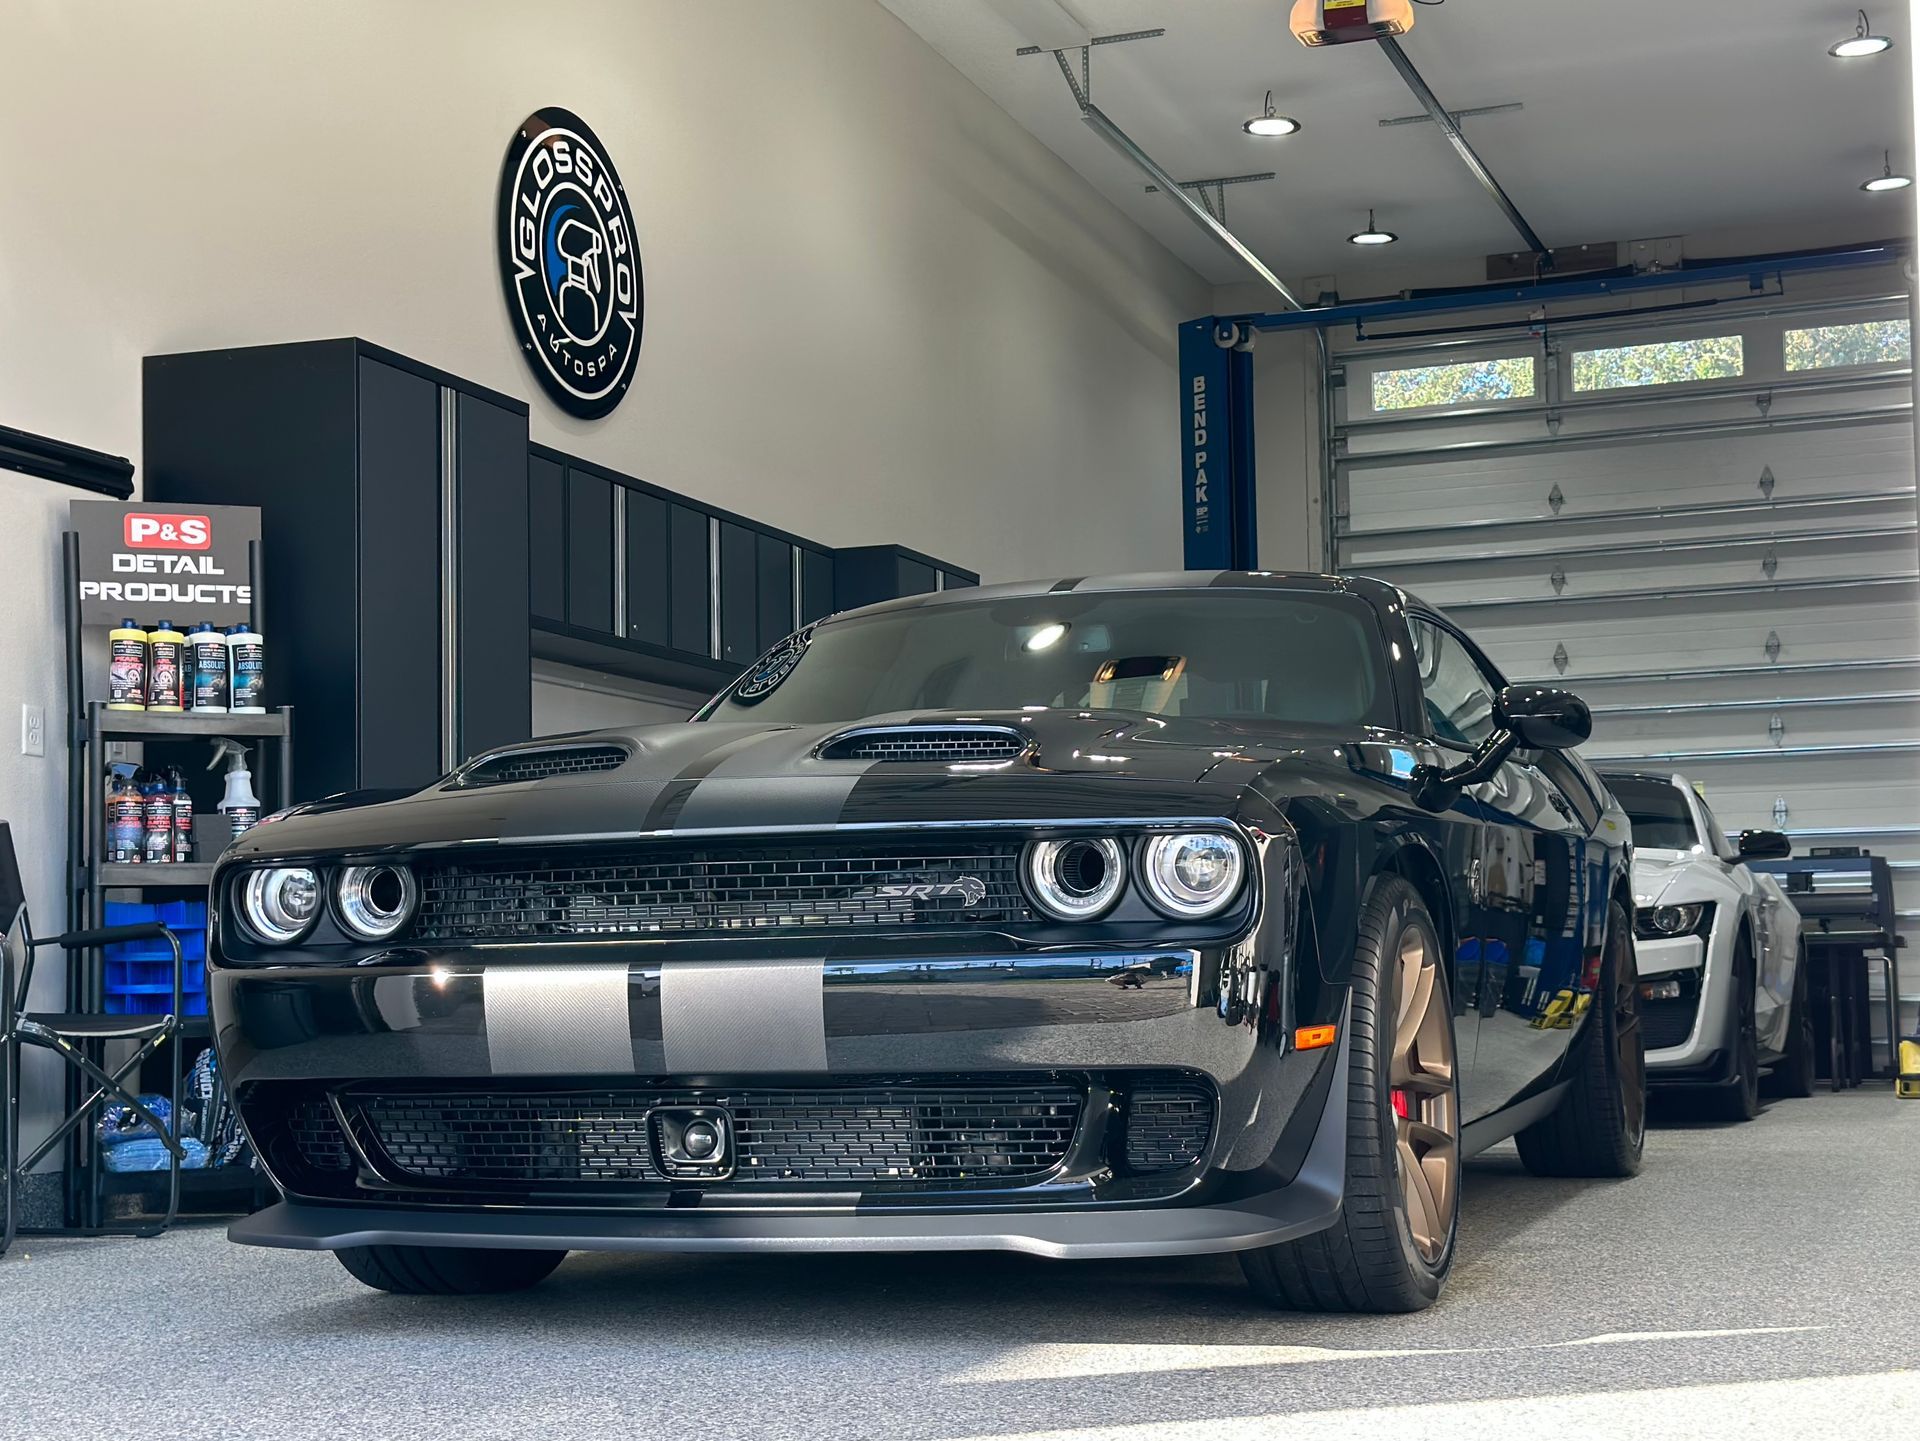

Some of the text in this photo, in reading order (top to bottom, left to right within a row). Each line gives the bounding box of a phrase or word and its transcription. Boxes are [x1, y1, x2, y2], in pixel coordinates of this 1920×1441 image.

[519, 140, 631, 305] GLOSSPRO
[537, 313, 617, 377] AUTOSPA
[130, 518, 207, 545] P&S
[112, 553, 225, 575] DETAIL
[79, 581, 252, 604] PRODUCTS
[875, 884, 963, 900] SRT
